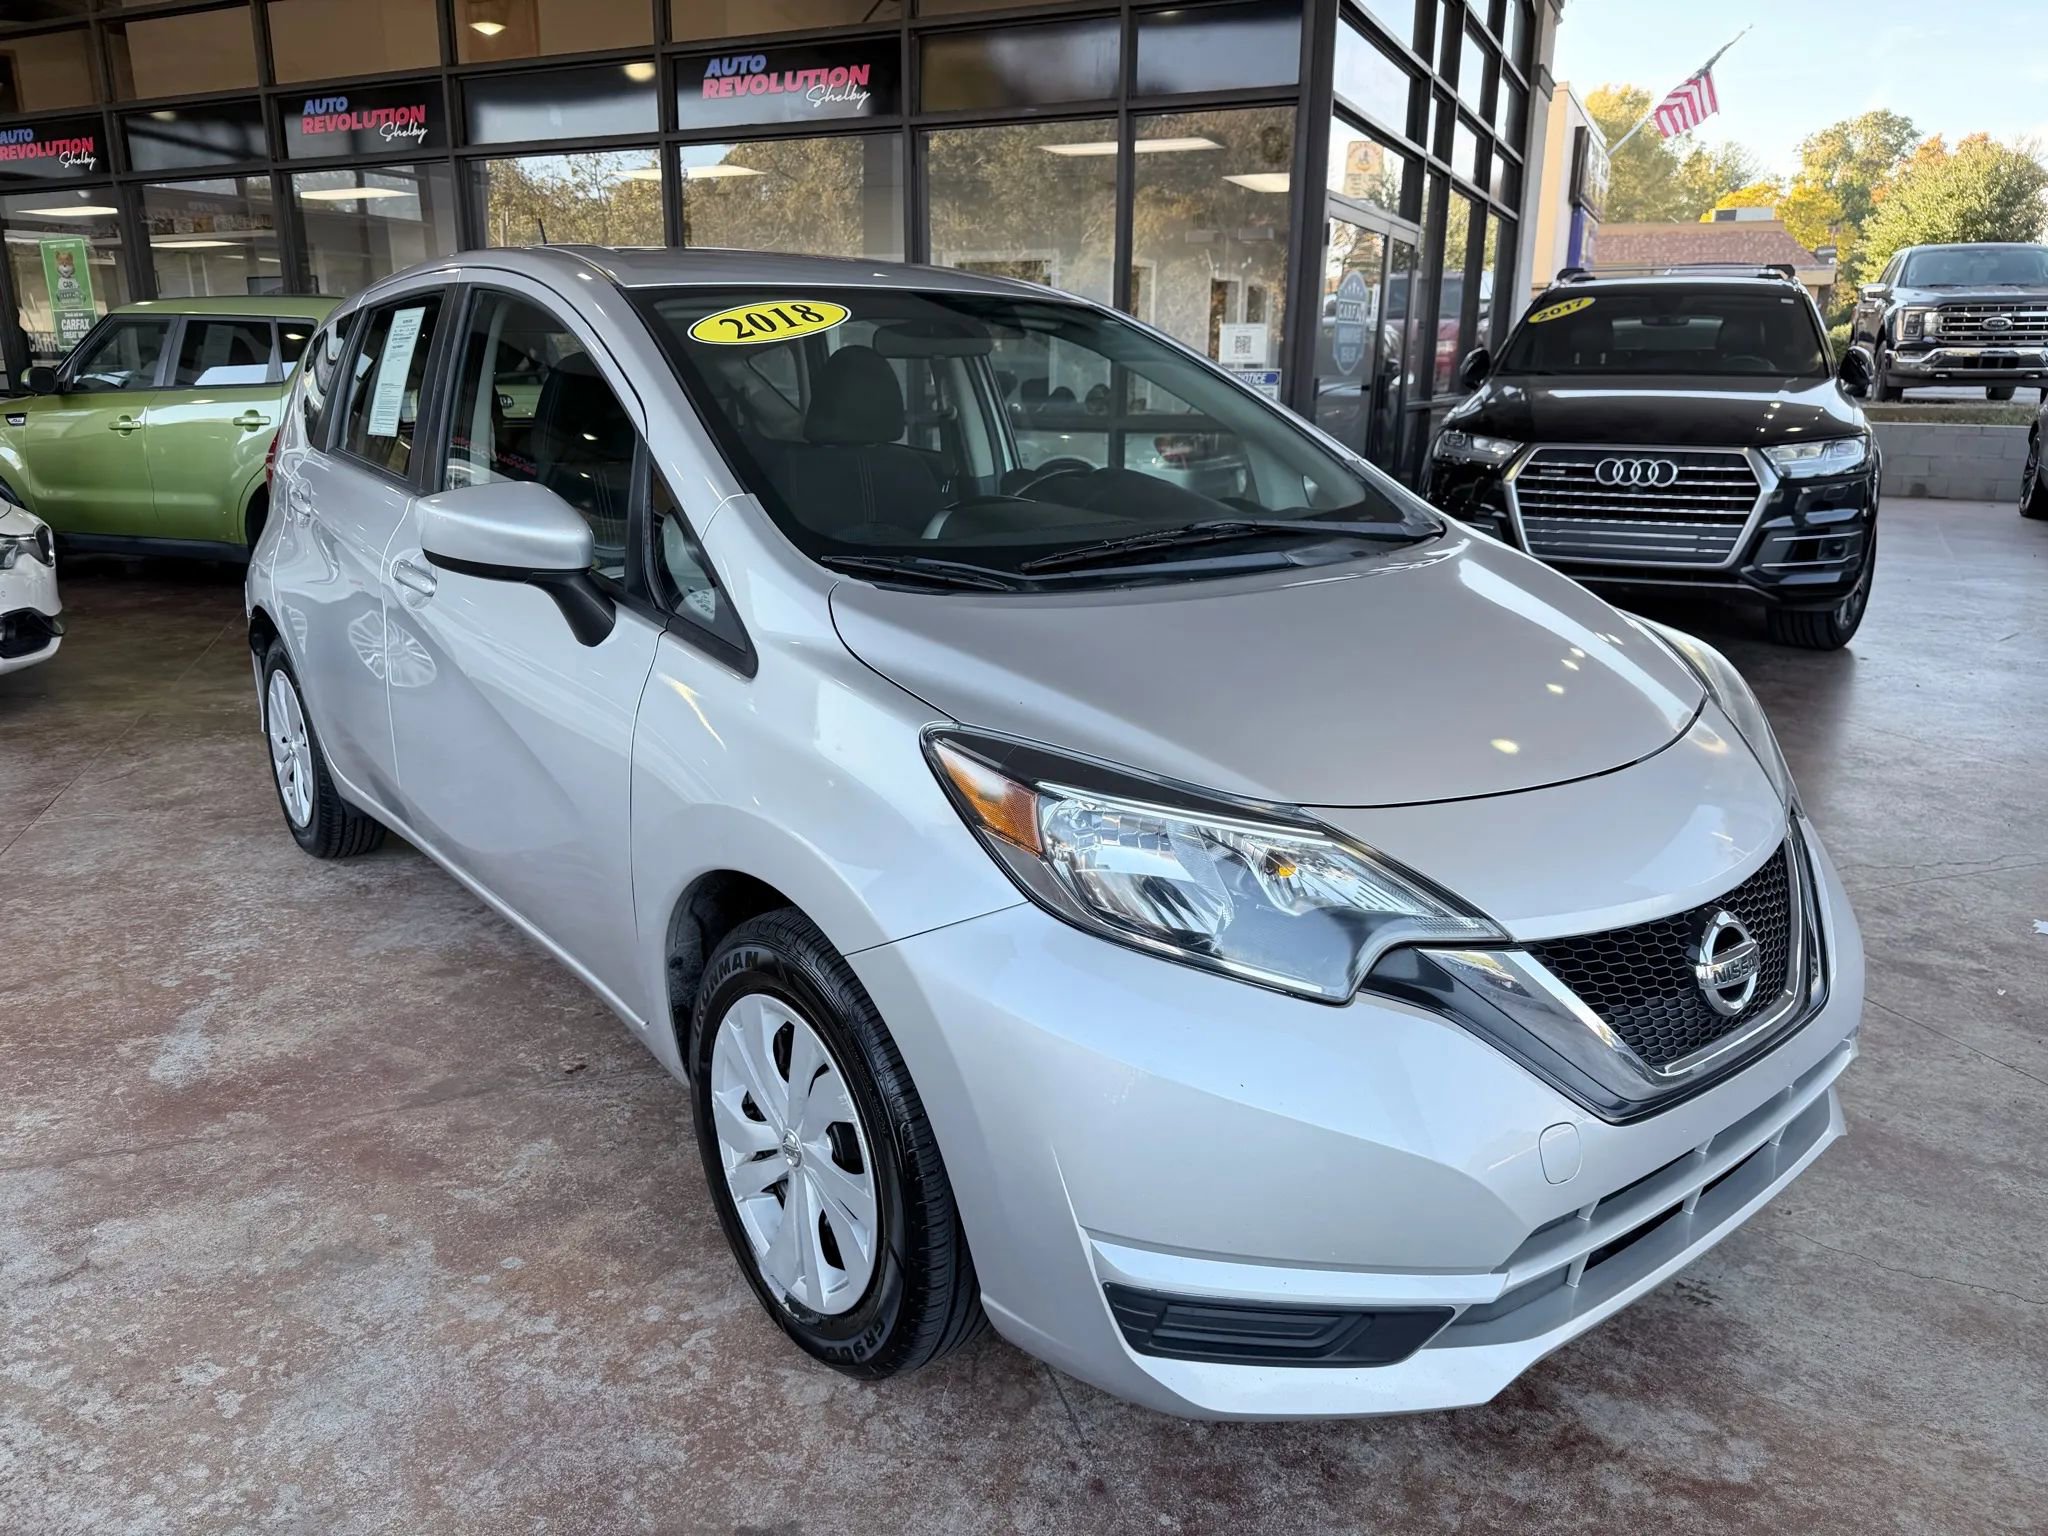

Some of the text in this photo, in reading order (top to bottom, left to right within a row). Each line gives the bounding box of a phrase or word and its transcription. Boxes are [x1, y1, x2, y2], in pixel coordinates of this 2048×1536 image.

[704, 55, 766, 77] AUTO
[702, 64, 870, 99] REVOLUTION
[303, 97, 348, 115] AUTO
[806, 80, 870, 109] Shelby
[302, 105, 426, 134] REVOLUTION
[380, 119, 427, 144] Shelby
[0, 129, 33, 144] AUTO
[0, 137, 93, 161] REVOLUTION
[59, 148, 96, 171] Shelby
[719, 304, 825, 339] 2018
[1536, 298, 1585, 321] 2017
[61, 318, 90, 331] CARFAX
[1713, 952, 1760, 986] NISSAN
